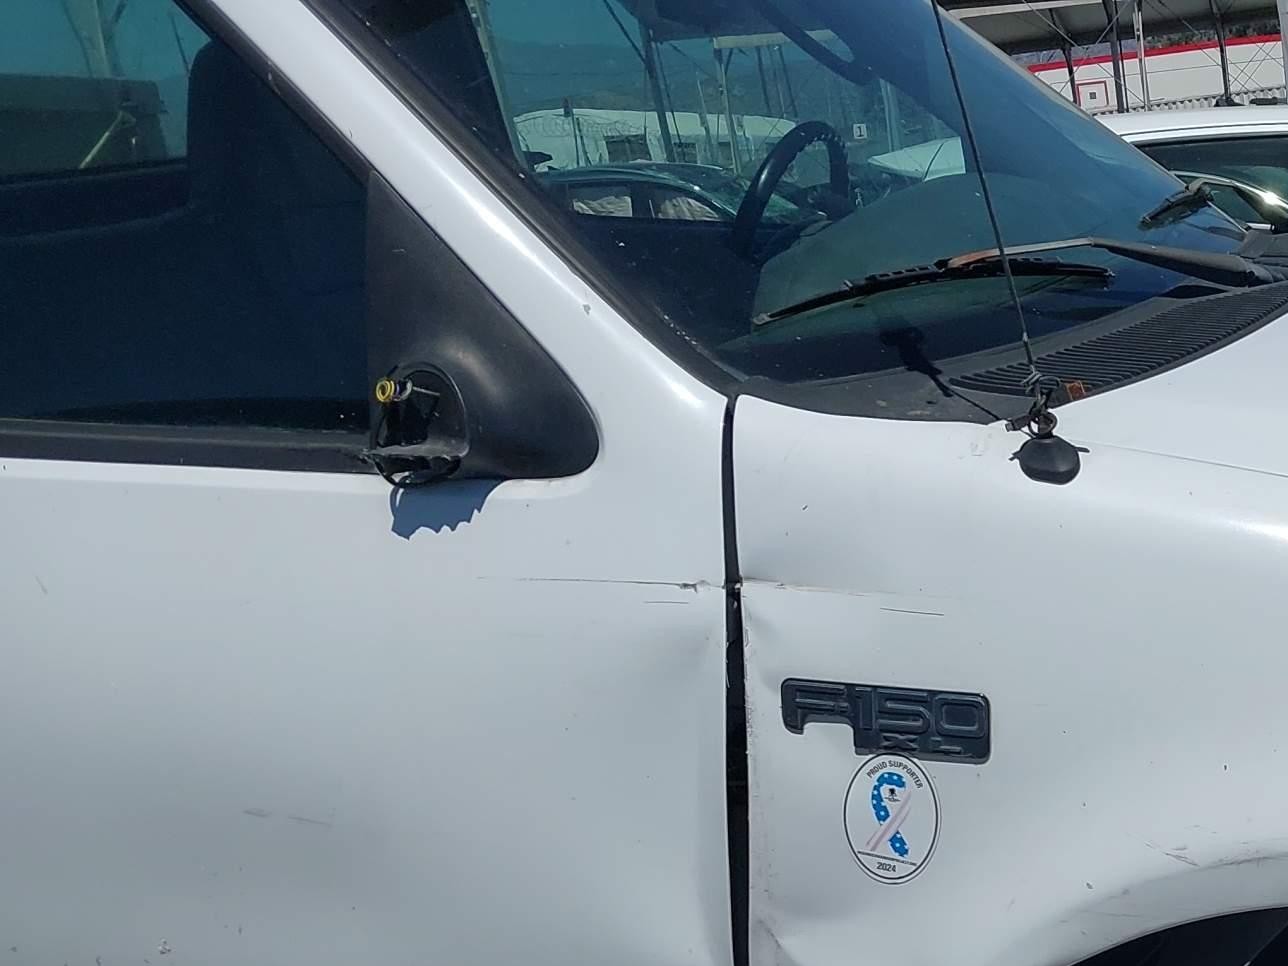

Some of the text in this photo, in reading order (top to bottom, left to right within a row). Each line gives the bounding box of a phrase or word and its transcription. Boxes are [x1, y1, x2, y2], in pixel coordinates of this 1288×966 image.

[867, 760, 924, 789] PROUD SUPPORTER
[876, 861, 897, 873] 2024
